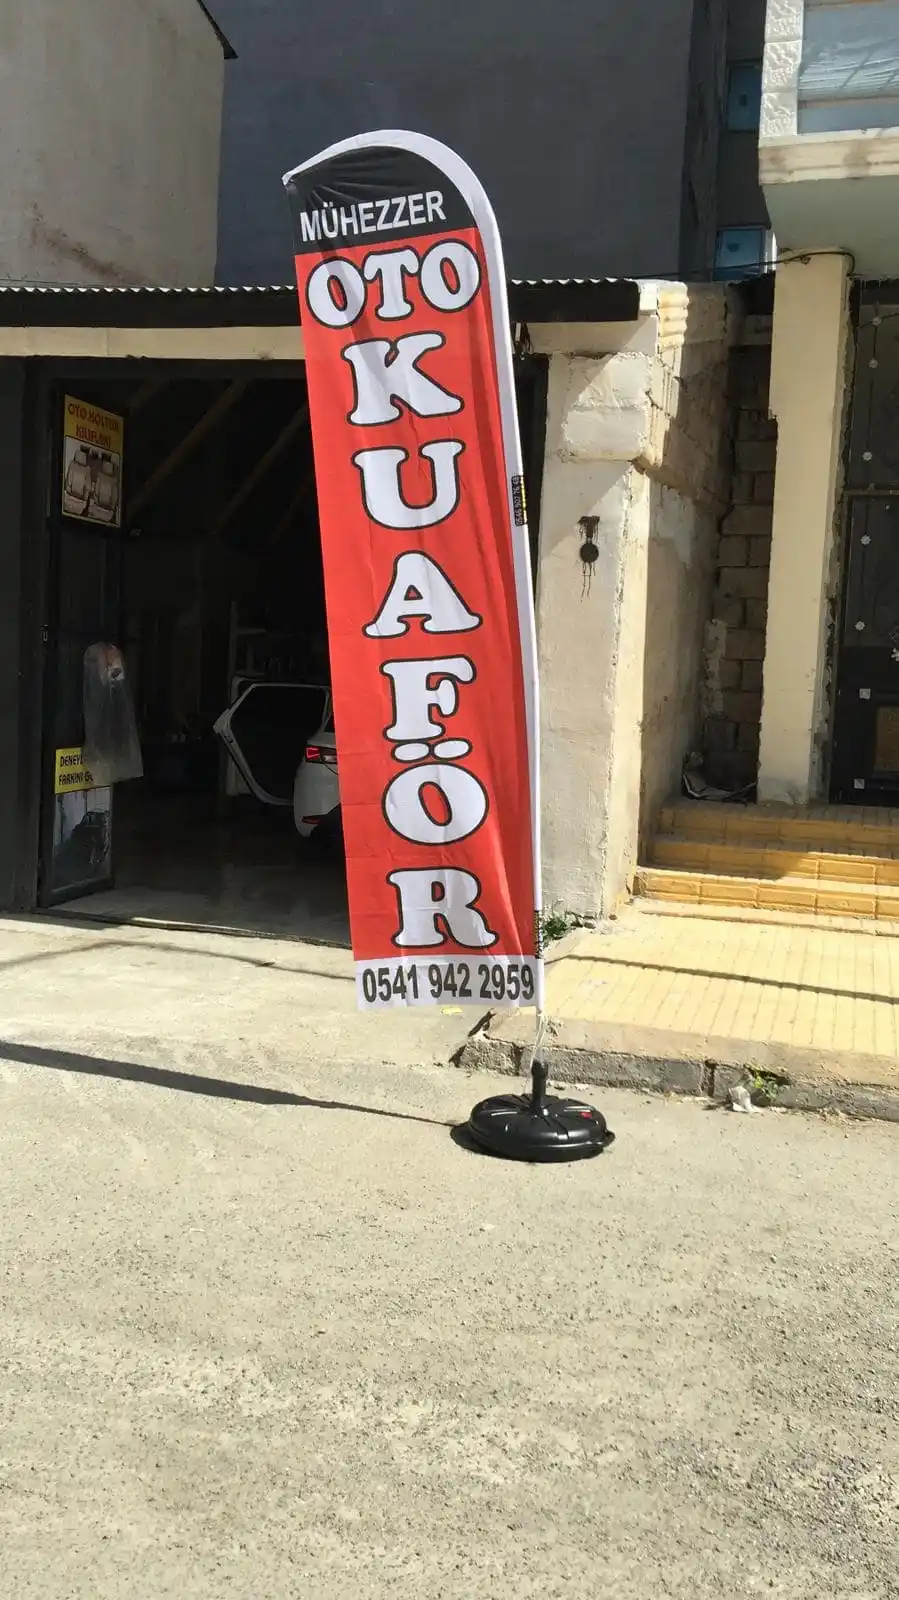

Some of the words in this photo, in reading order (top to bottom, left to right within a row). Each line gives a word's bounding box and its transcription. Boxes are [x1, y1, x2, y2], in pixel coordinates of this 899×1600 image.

[299, 190, 447, 242] MÜHEZZER
[306, 238, 482, 329] OTO
[68, 403, 87, 420] OTO
[362, 964, 419, 1003] 0541
[428, 962, 472, 998] 942
[477, 963, 535, 1001] 2959
